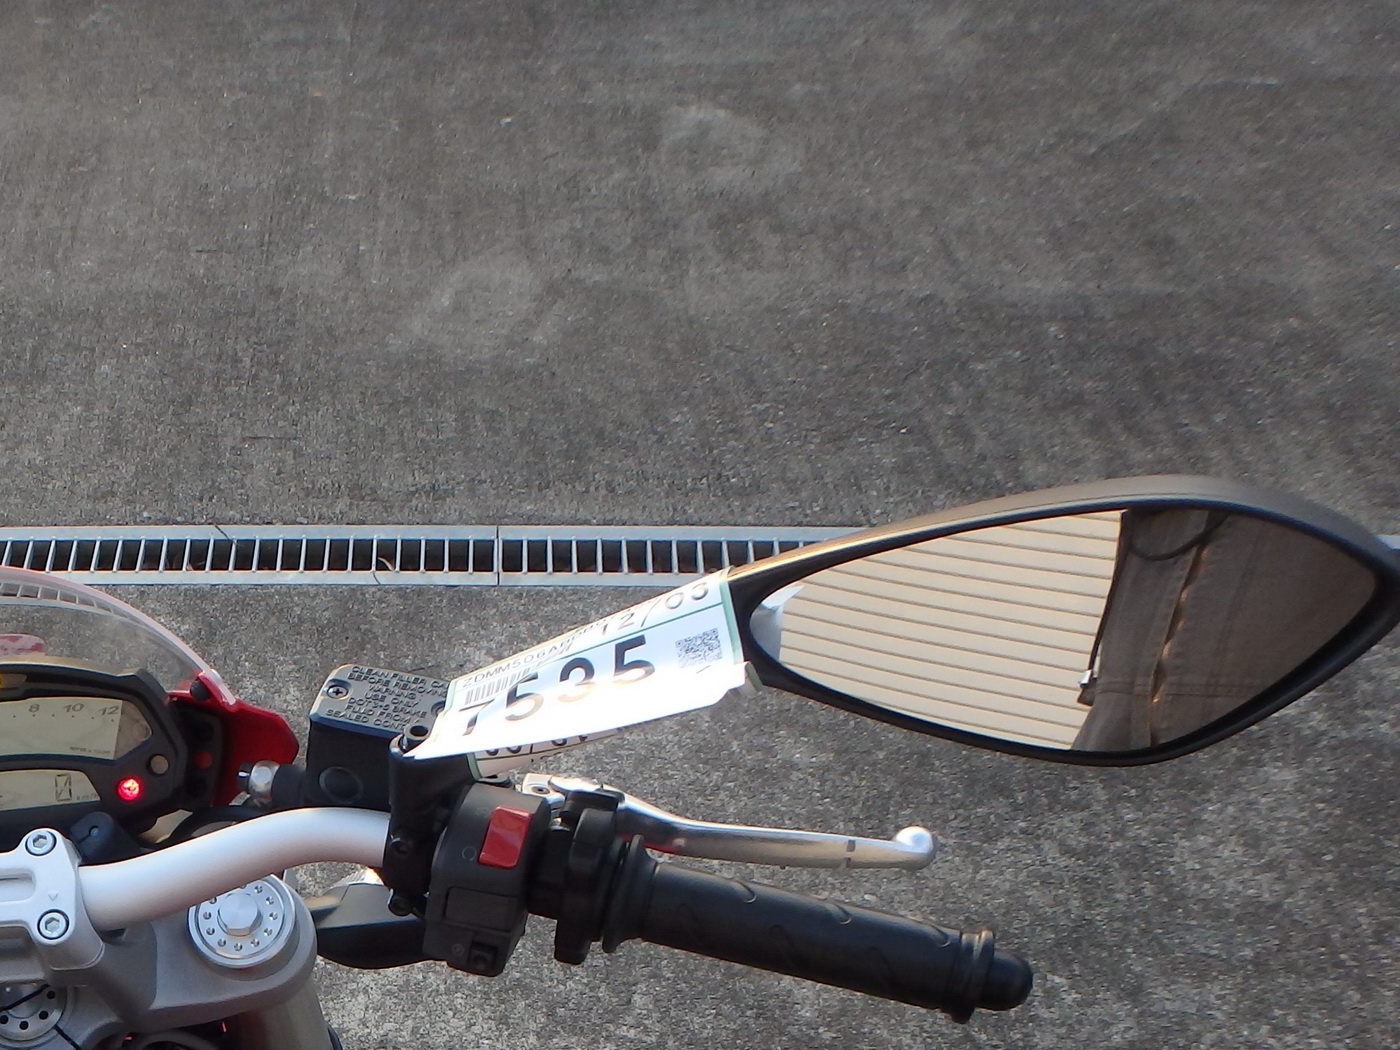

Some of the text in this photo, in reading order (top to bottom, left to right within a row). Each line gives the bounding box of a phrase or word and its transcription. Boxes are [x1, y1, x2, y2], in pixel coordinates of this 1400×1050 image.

[348, 673, 391, 687] BEFORE
[351, 666, 388, 679] CLEAN
[391, 673, 428, 686] FILLER
[458, 634, 656, 737] 7535
[365, 693, 387, 703] USE
[28, 704, 40, 713] 8
[63, 703, 85, 713] 10
[98, 705, 120, 716] 12
